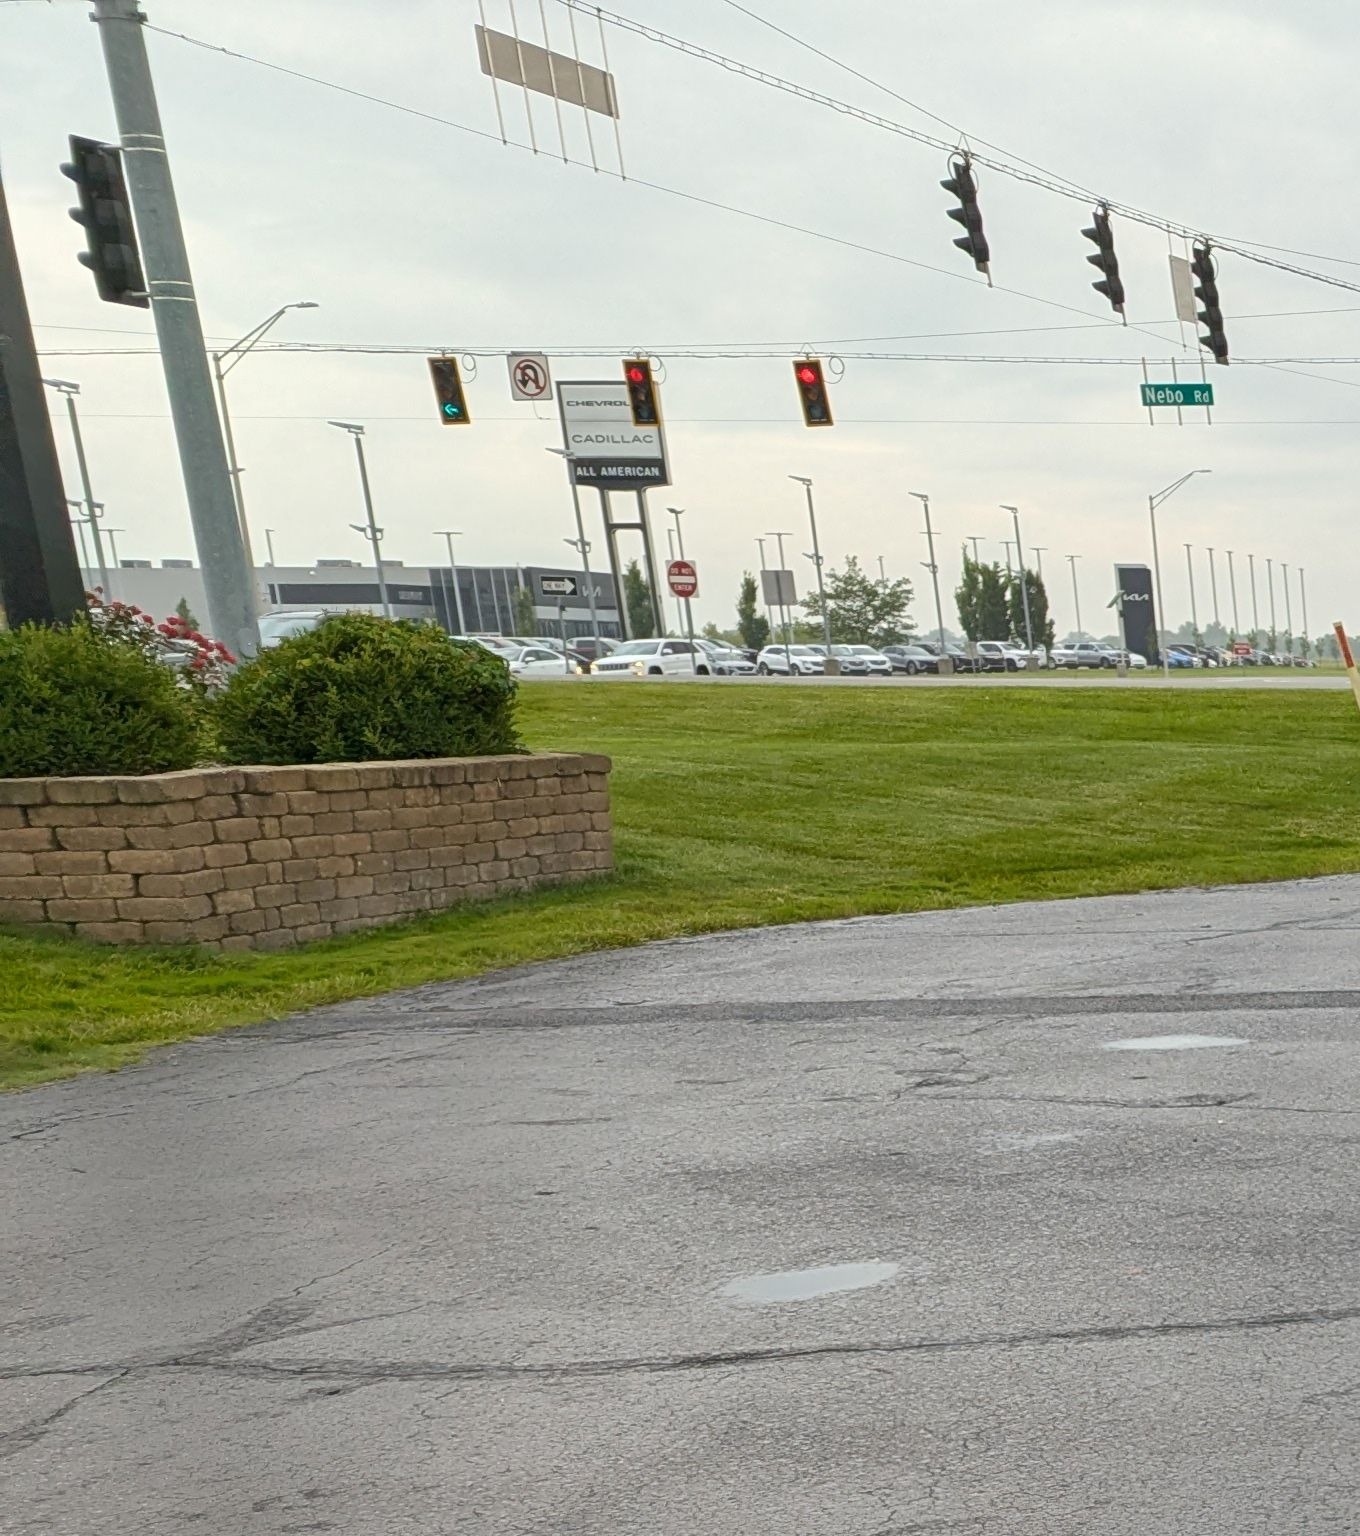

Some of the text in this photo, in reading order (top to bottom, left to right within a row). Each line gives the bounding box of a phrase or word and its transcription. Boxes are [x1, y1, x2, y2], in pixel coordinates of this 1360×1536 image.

[1145, 387, 1210, 403] Nebo Rd
[571, 434, 654, 443] CADILLAC
[576, 466, 660, 476] ALL AMERICAN
